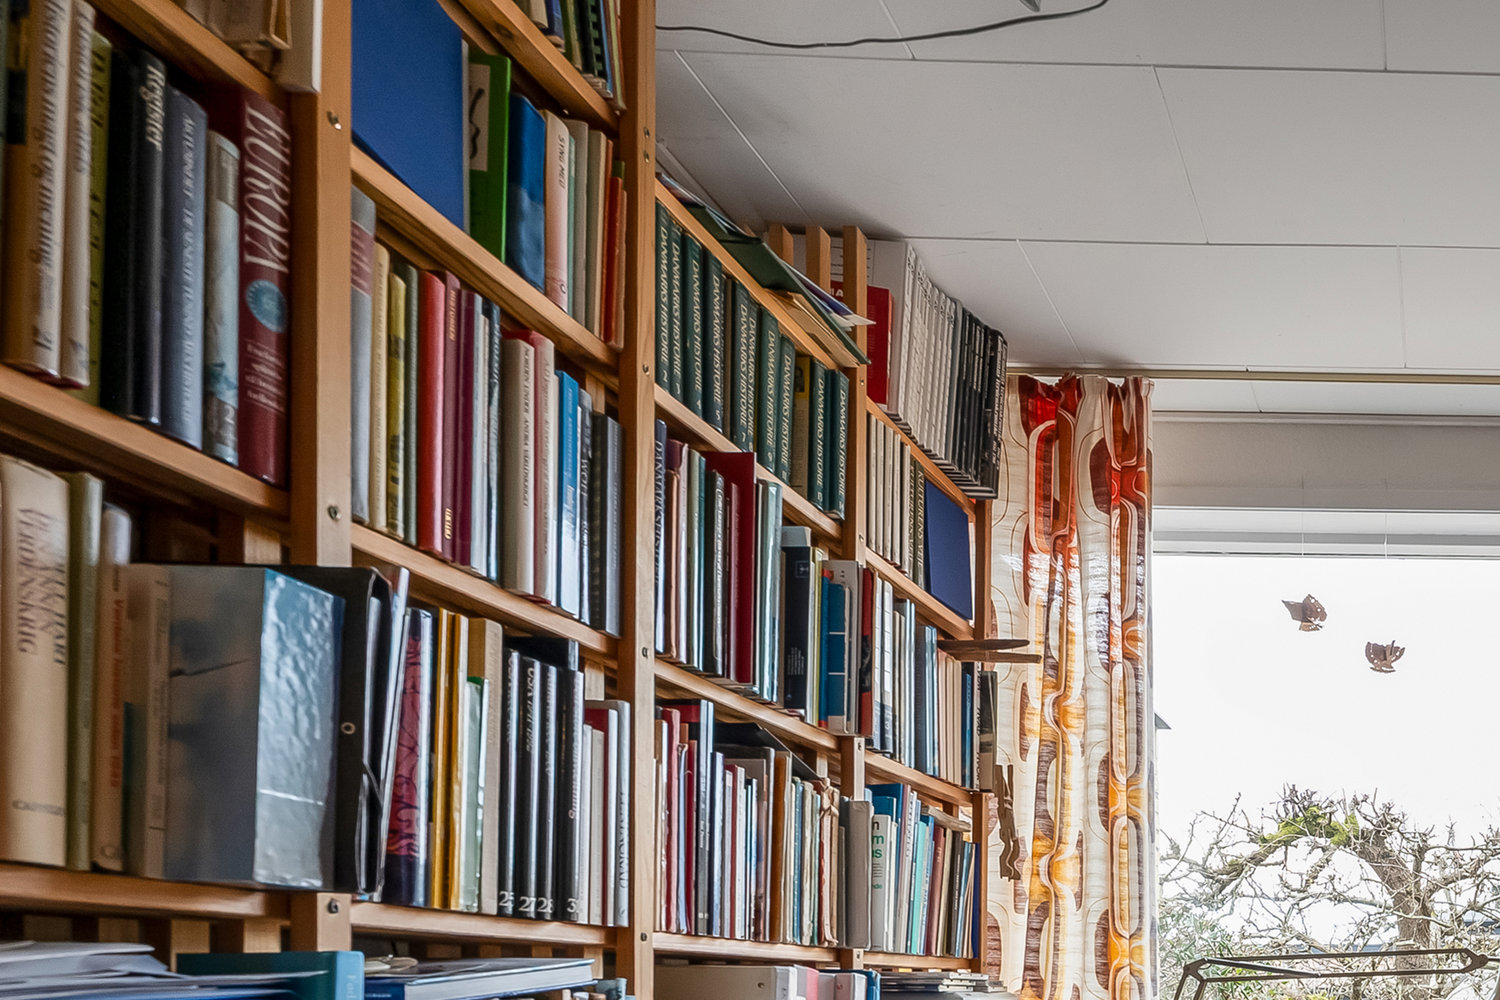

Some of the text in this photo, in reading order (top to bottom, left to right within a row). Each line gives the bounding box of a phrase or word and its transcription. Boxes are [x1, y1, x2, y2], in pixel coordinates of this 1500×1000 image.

[146, 64, 165, 151] Register
[243, 105, 291, 275] EUROPA
[659, 226, 669, 299] DANMARKS
[672, 241, 682, 316] DANMARKS
[691, 258, 702, 334] DANMARKS
[712, 274, 722, 346] DANMARKS
[659, 300, 669, 365] HISTORIE
[672, 317, 682, 377] HISTORIE
[739, 303, 748, 366] DANMARKS
[747, 316, 757, 378] DANMARKS
[766, 330, 776, 391] DANMARKS
[691, 335, 702, 393] HISTORIE
[712, 347, 722, 404] HISTORIE
[781, 354, 792, 415] DANMARKS
[739, 367, 748, 428] HISTORIE
[747, 378, 757, 437] HISTORIE
[766, 392, 776, 447] HISTORIE
[816, 378, 825, 438] DANMARKS
[838, 389, 847, 448] DANMARKS
[781, 416, 791, 466] HISTORIE
[816, 439, 825, 487] HISTORIE
[838, 449, 847, 497] HISTORIE
